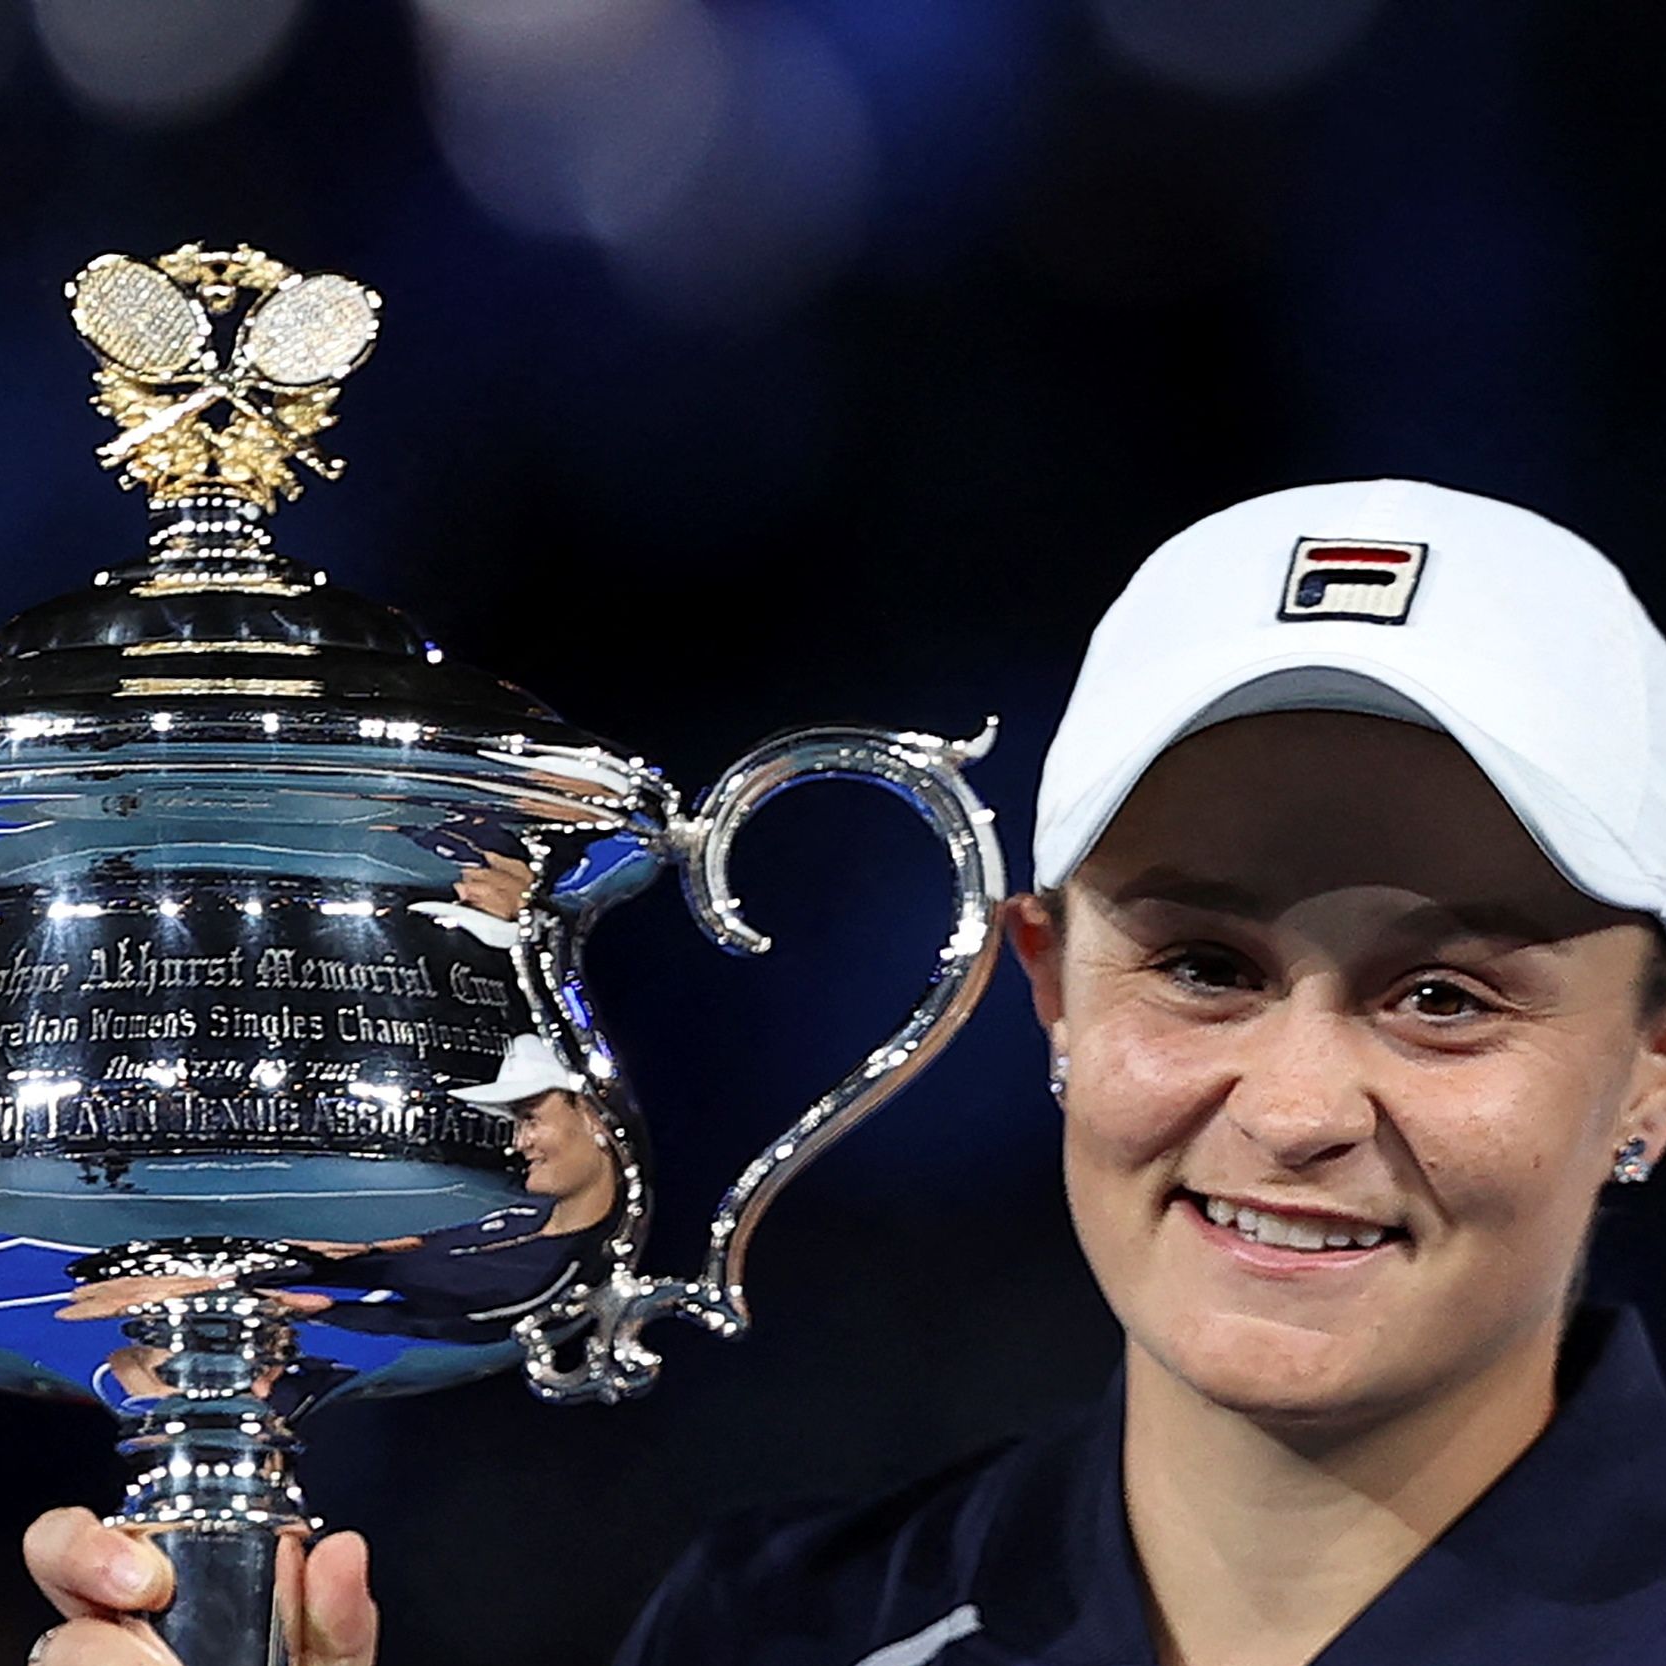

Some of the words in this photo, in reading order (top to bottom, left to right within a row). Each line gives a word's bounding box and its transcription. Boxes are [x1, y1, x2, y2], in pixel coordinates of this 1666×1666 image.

[79, 937, 245, 996] Akhurst
[255, 947, 438, 998] Memorial
[209, 1005, 324, 1049] Singles
[310, 1090, 517, 1147] ASSOCIATIO
